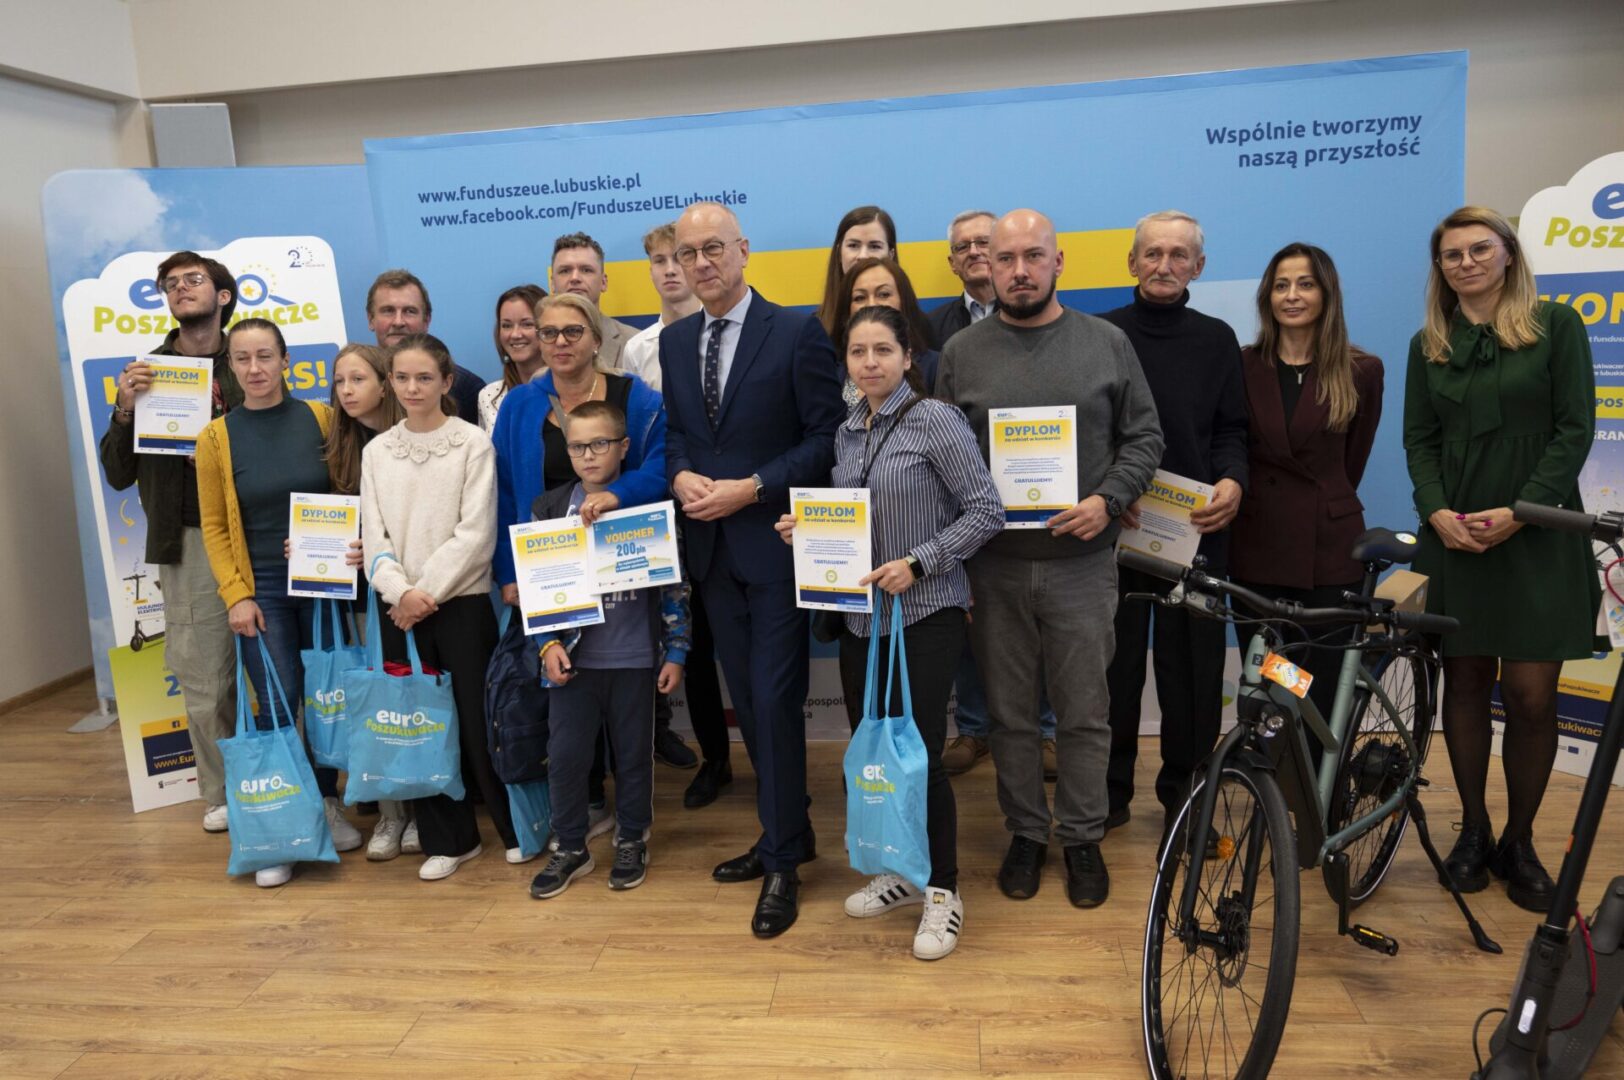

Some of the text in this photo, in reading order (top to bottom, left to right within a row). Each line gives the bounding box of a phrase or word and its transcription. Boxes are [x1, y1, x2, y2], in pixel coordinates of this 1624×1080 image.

[1206, 114, 1422, 147] Wspólnie tworzymy
[1238, 136, 1421, 169] naszą przyszłość
[418, 173, 641, 204] www.funduszeue.lubuskie.pl
[421, 190, 747, 228] www.facebook.com/FunduszeUELubuskie
[1005, 424, 1060, 437] DYPLOM
[1594, 430, 1624, 441] RAN
[302, 508, 347, 519] DYPLOM
[804, 506, 856, 517] DYPLOM
[526, 532, 577, 549] DYPLOM
[605, 527, 655, 544] VOUCHER
[376, 709, 425, 728] euro
[153, 755, 195, 769] www.Eur
